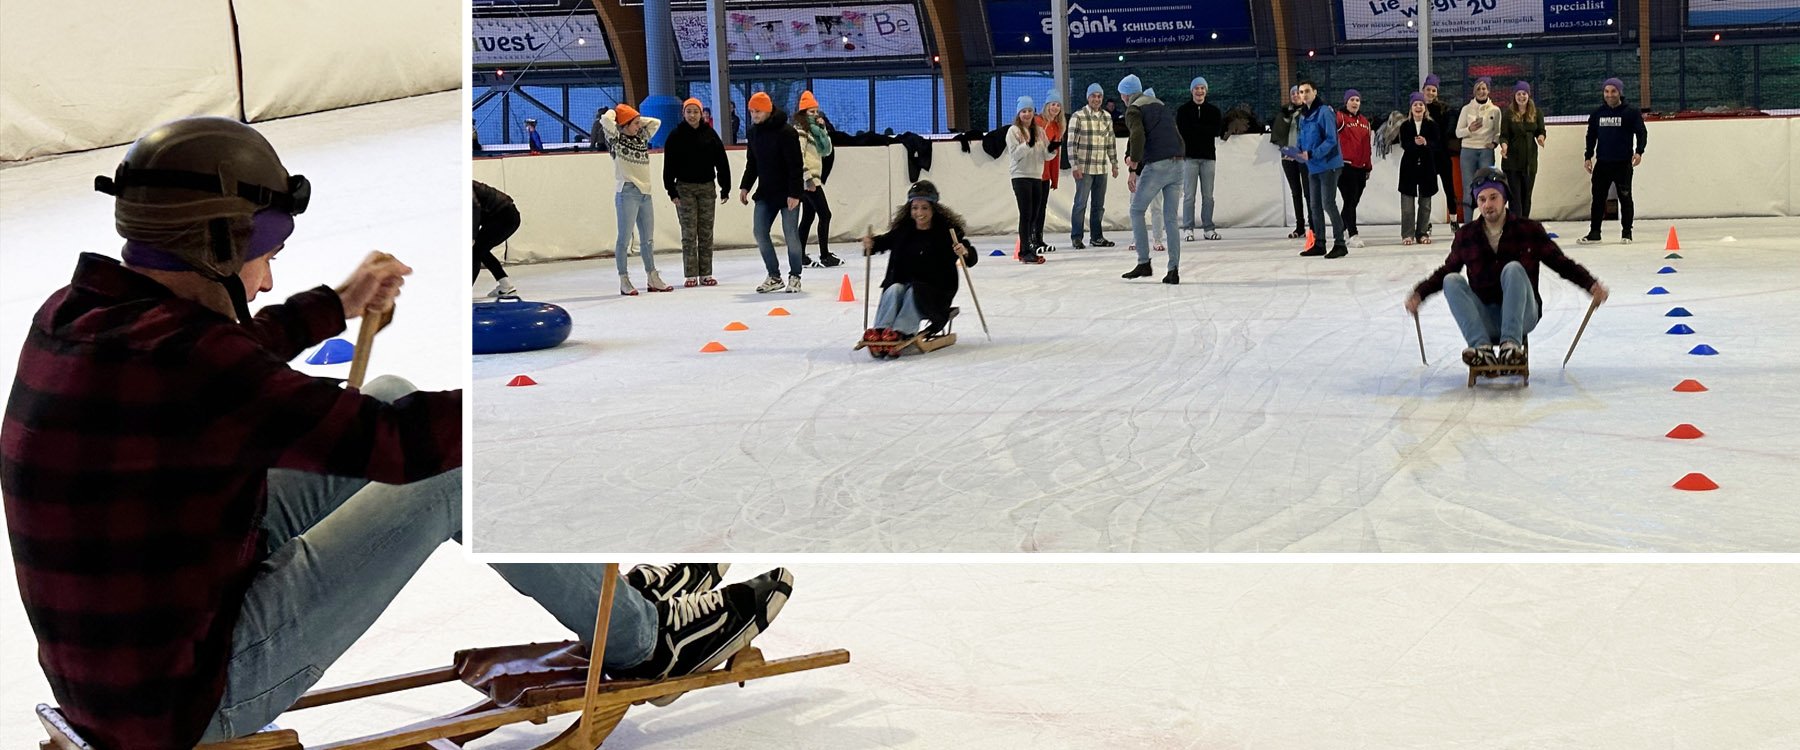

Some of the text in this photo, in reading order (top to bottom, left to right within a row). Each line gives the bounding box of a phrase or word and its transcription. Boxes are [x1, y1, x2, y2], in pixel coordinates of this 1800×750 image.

[1549, 0, 1605, 14] specialist
[874, 11, 911, 36] Be
[1041, 15, 1195, 39] Egink SCHILDERS B.V.
[1125, 36, 1156, 44] Kwaliteit
[1158, 35, 1176, 43] sinds
